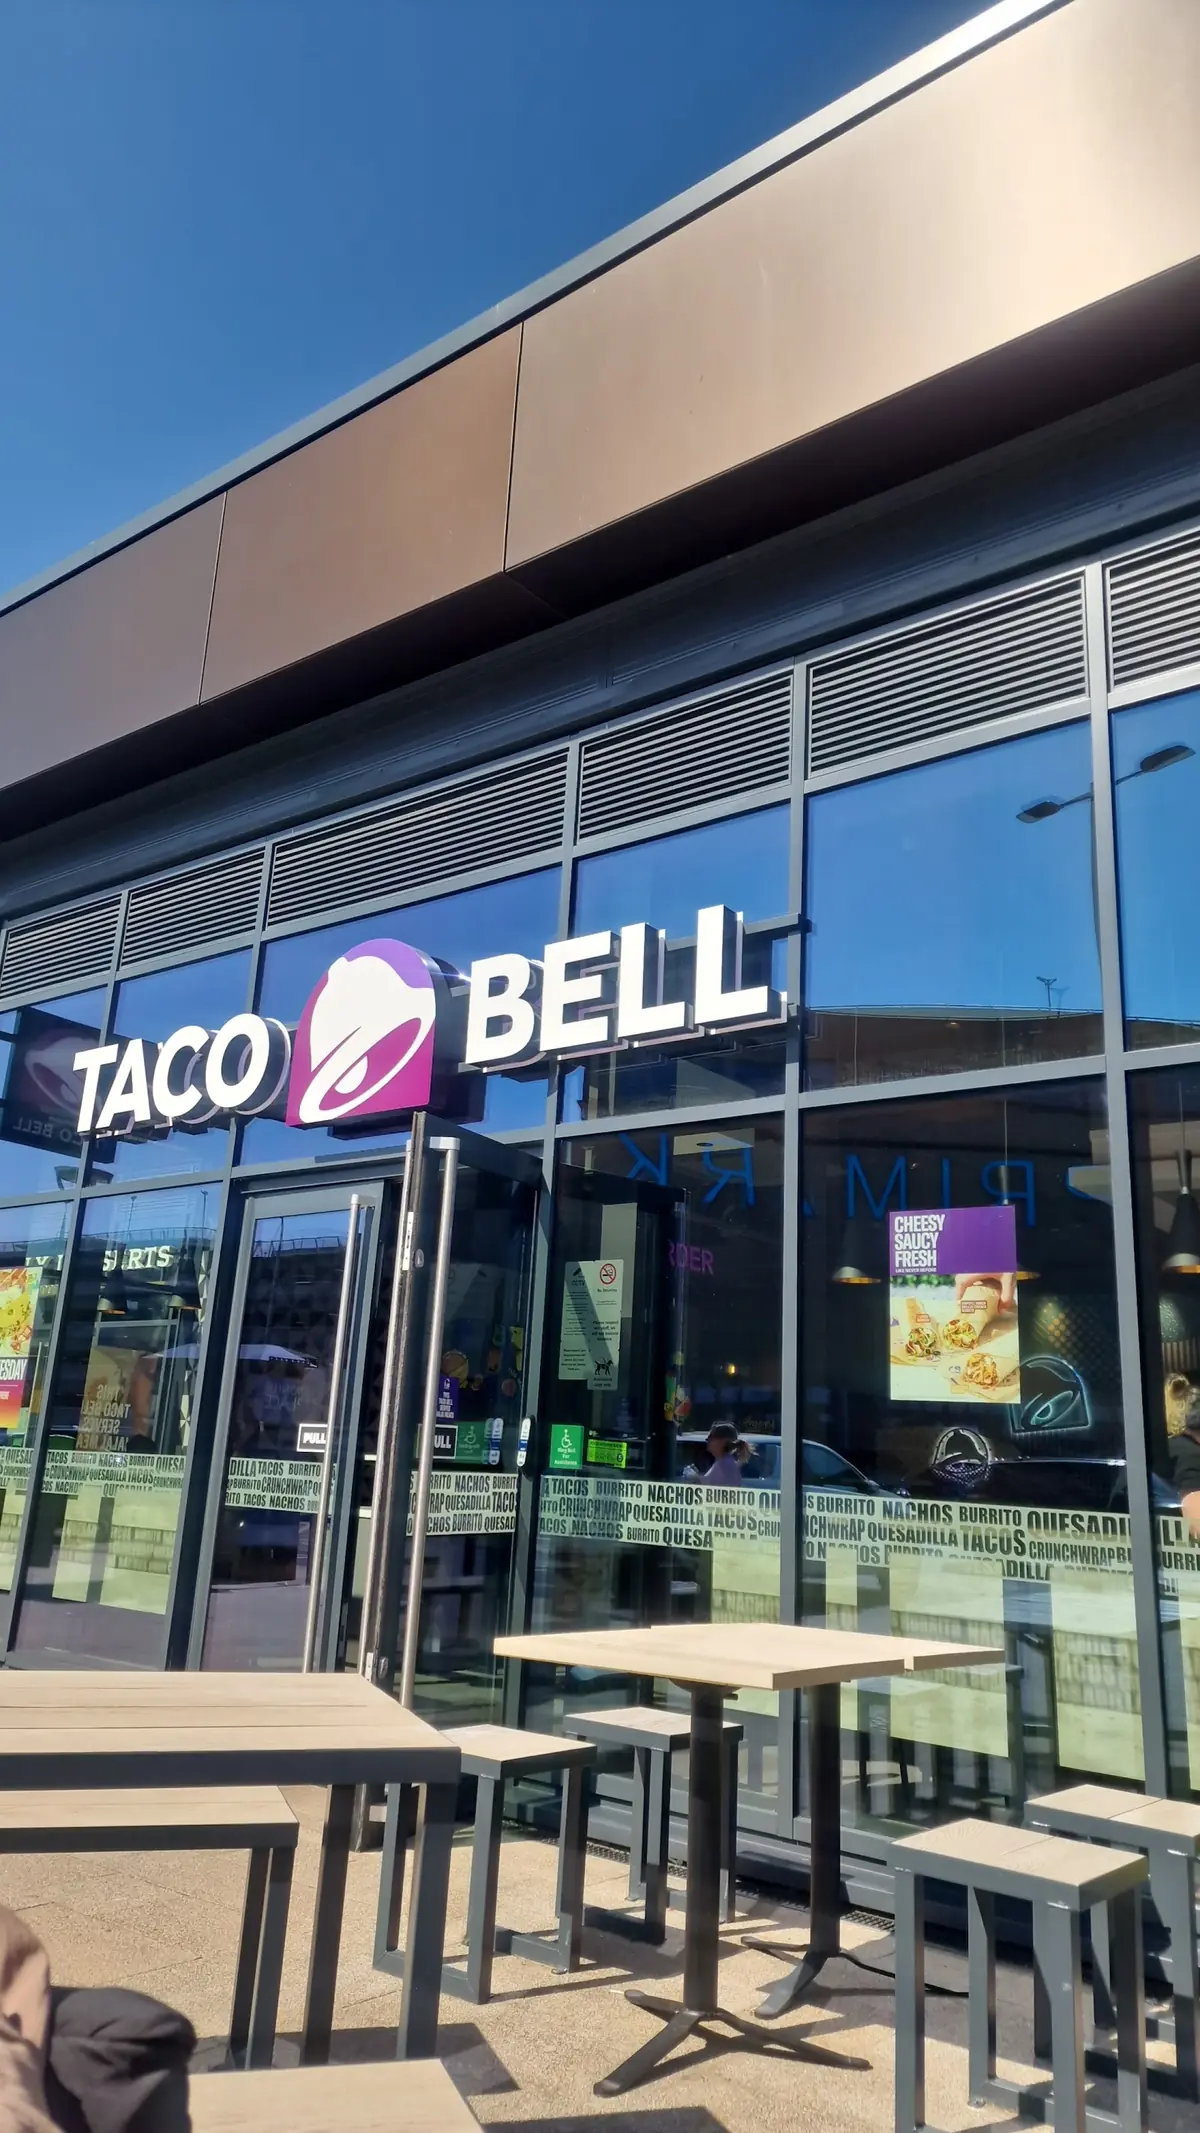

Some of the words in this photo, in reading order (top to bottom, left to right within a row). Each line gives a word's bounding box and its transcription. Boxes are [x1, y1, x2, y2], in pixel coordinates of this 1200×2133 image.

[73, 1013, 271, 1133] TACO
[465, 905, 768, 1064] BELL
[894, 1214, 945, 1233] CHEESY
[894, 1232, 939, 1250] SAUCY
[895, 1250, 937, 1268] FRESH
[303, 1432, 327, 1444] PULL
[434, 1435, 451, 1449] ULL
[48, 1452, 68, 1464] TACOS
[129, 1455, 155, 1467] BURRITO
[89, 1468, 127, 1482] QUESADILLA
[128, 1468, 153, 1484] TACOS
[258, 1461, 284, 1476] TACOS
[288, 1463, 321, 1477] BURRITO
[233, 1478, 261, 1490] BURRITO
[261, 1476, 313, 1496] CRUNCHWRAP
[454, 1475, 490, 1493] NACHOS
[552, 1478, 589, 1497] TACOS
[596, 1480, 643, 1498] BURRITO
[648, 1484, 703, 1506] NACHOS
[706, 1488, 755, 1506] BURRITO
[243, 1493, 267, 1507] TACOS
[269, 1495, 305, 1511] NACHOS
[445, 1494, 491, 1512] QUESADILLA
[559, 1496, 631, 1522] CRUNCHWRAP
[633, 1503, 704, 1527] QUESADILLA
[706, 1506, 757, 1531] TACOS
[817, 1496, 875, 1517] BURRITO
[882, 1500, 953, 1526] NACHOS
[959, 1505, 1022, 1527] BURRITO
[451, 1513, 482, 1532] BURRITO
[571, 1518, 623, 1540] NACHOS
[626, 1526, 660, 1543] BURRITO
[867, 1521, 959, 1548] QUESADILLA
[960, 1524, 1026, 1557] TACOS
[1029, 1540, 1115, 1567] CRUNCHWRAP
